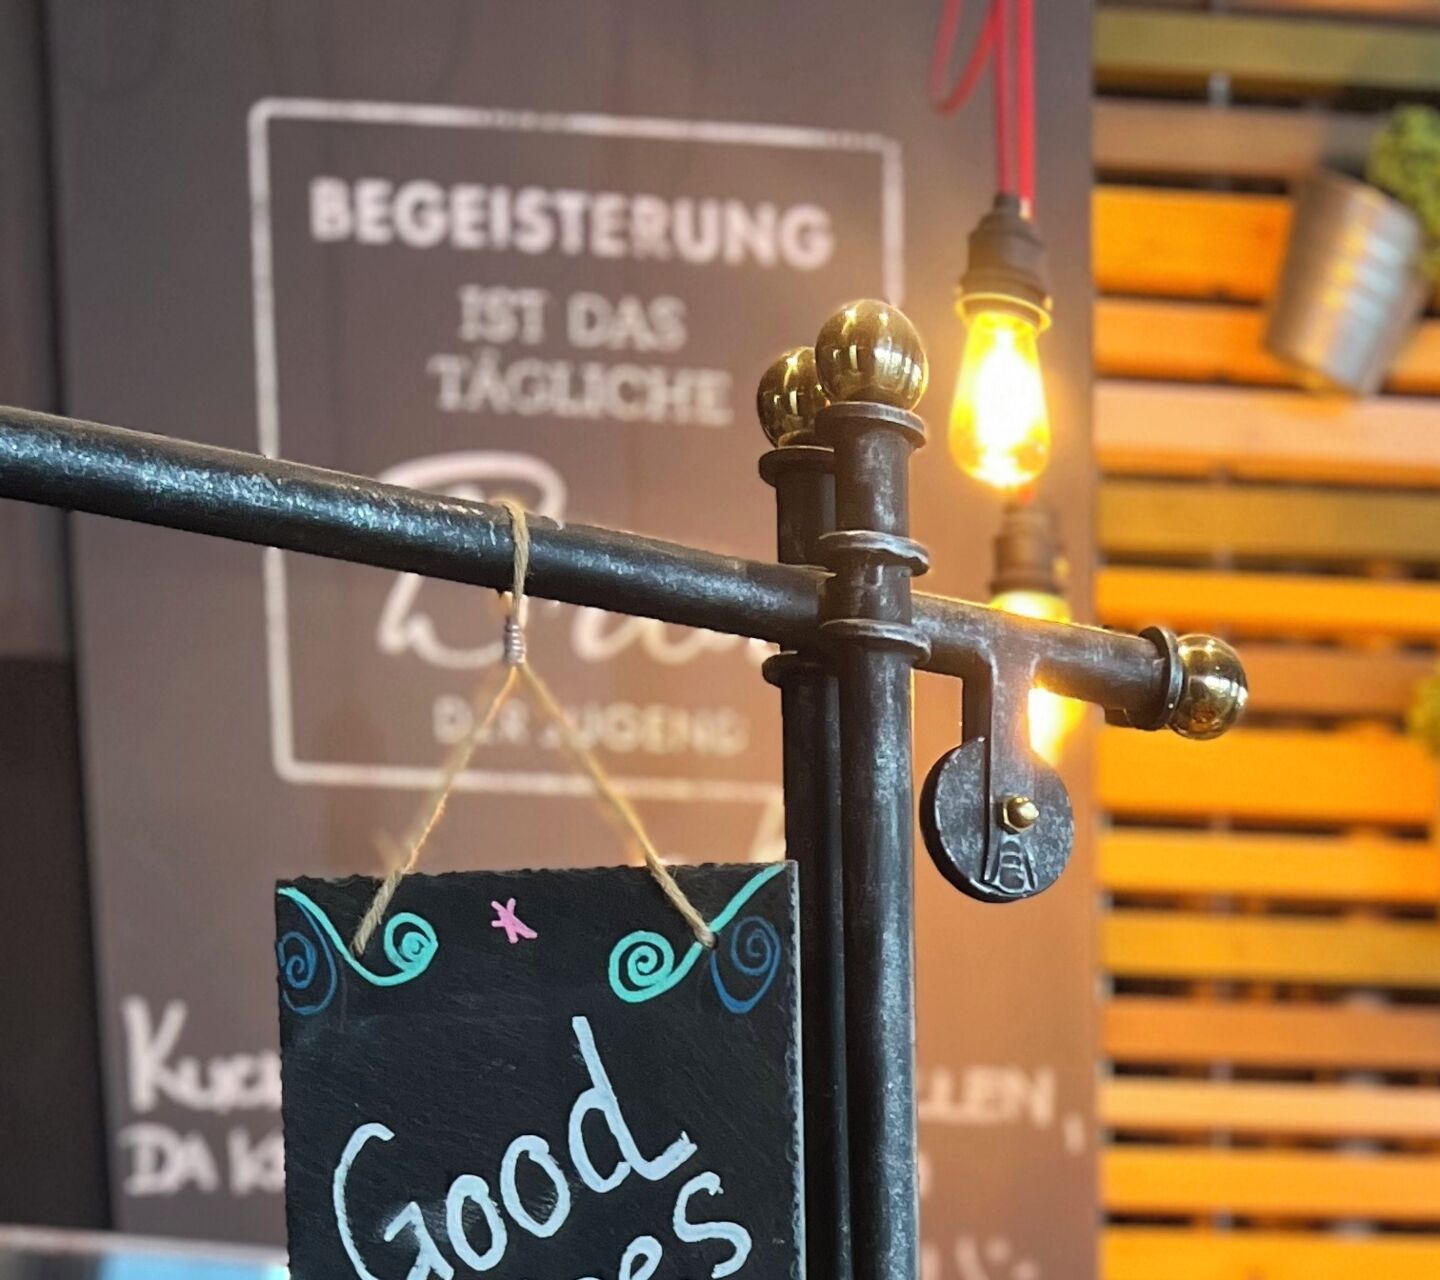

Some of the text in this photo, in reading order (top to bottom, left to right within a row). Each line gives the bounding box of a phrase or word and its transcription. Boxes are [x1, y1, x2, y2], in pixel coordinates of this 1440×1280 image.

[310, 177, 834, 270] BEGEISTERUNG
[458, 284, 686, 351] IST DAS
[426, 346, 734, 427] TÄGLICHE
[432, 695, 528, 745] DR
